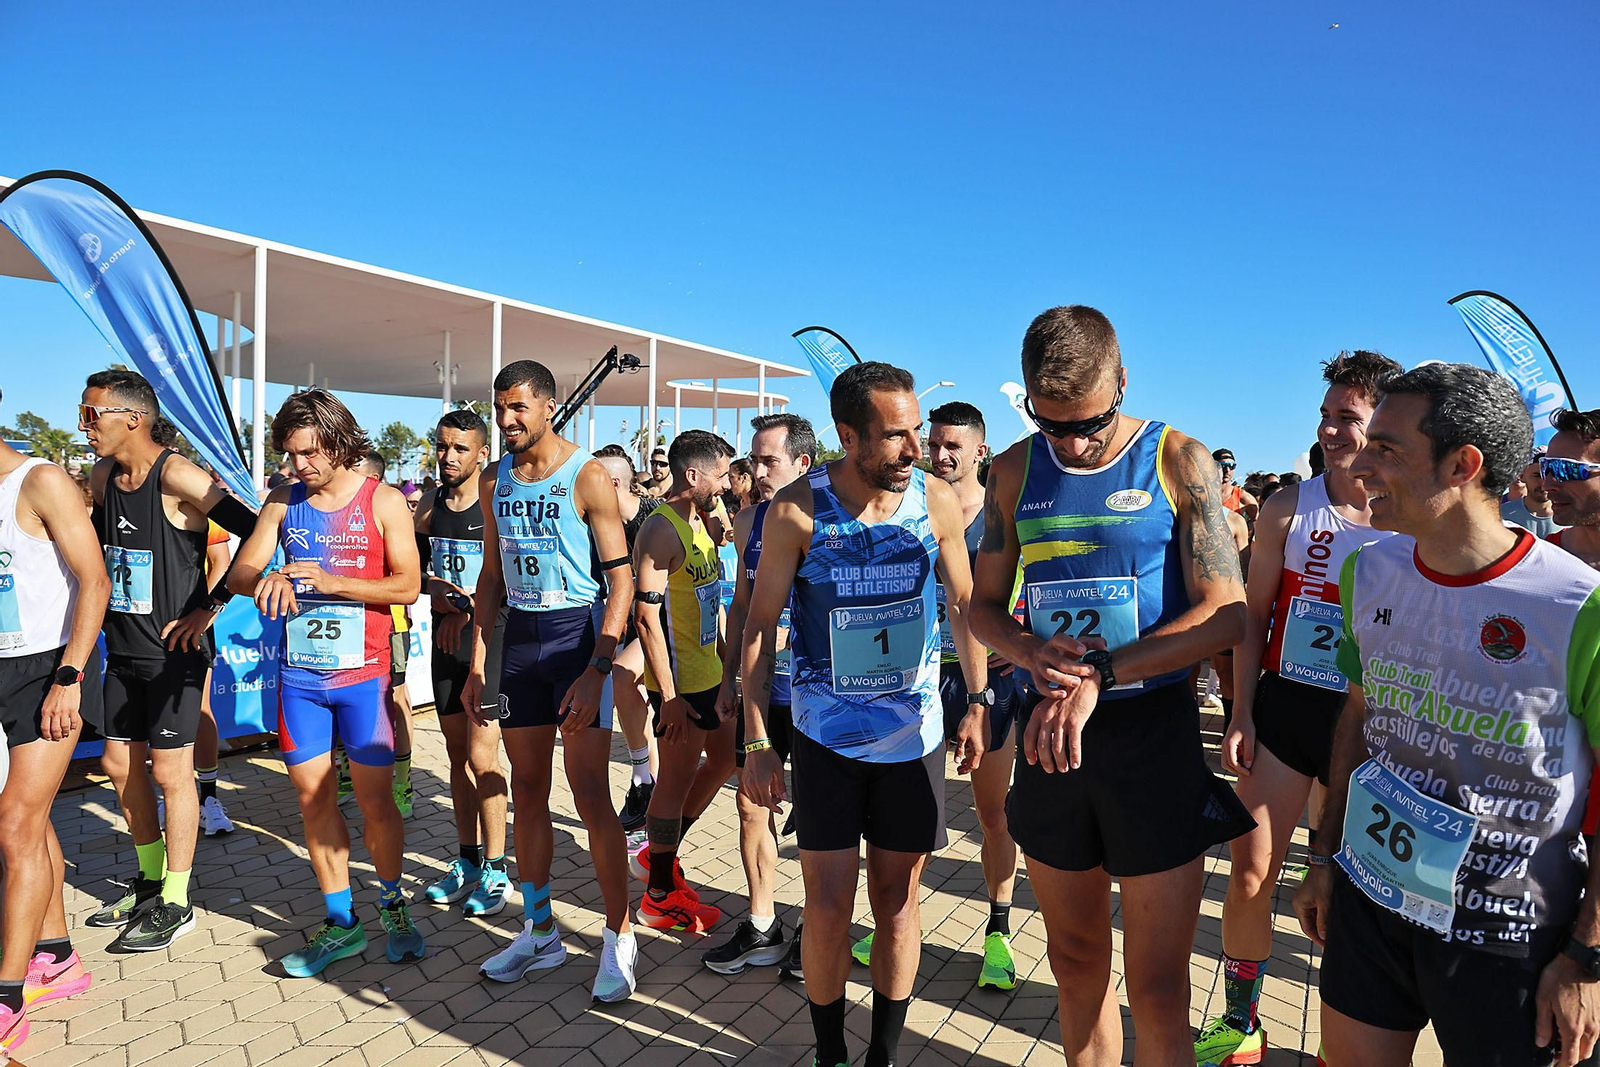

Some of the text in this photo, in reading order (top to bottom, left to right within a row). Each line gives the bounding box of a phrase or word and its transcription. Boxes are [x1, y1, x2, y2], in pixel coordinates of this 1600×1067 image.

[498, 494, 560, 523] nerja
[1021, 499, 1054, 511] ANAKY
[315, 532, 369, 547] lapalma
[442, 554, 466, 573] 30
[513, 555, 540, 576] 18
[831, 563, 920, 581] CLUB ONUBENSE
[113, 564, 132, 585] 12
[837, 579, 915, 596] DE ATLETISMO
[1041, 589, 1063, 600] HUELVA
[1066, 587, 1103, 599] AVATEL
[1103, 585, 1129, 600] '24
[850, 612, 873, 621] HUELVA
[875, 609, 903, 621] AVATEL
[903, 603, 921, 617] '24
[1309, 605, 1331, 616] HUELVA
[307, 619, 341, 640] 25
[1050, 609, 1103, 639] 22
[873, 627, 889, 655] 1
[1310, 624, 1341, 651] 2
[300, 655, 335, 664] Wayalia
[213, 674, 276, 695] la ciudad
[851, 675, 898, 689] Wayalia
[1294, 664, 1340, 684] Wayalia
[1370, 659, 1433, 690] Club Trail
[1415, 689, 1531, 748] Abuela
[1472, 740, 1495, 758] de
[1497, 745, 1527, 766] los
[1484, 774, 1520, 792] Club
[1458, 784, 1540, 821] Sierra
[1392, 790, 1429, 820] AVATEL
[1431, 809, 1464, 837] '24
[1365, 803, 1416, 863] 26
[1351, 854, 1393, 898] Wayalia
[1382, 873, 1405, 888] MARTIN
